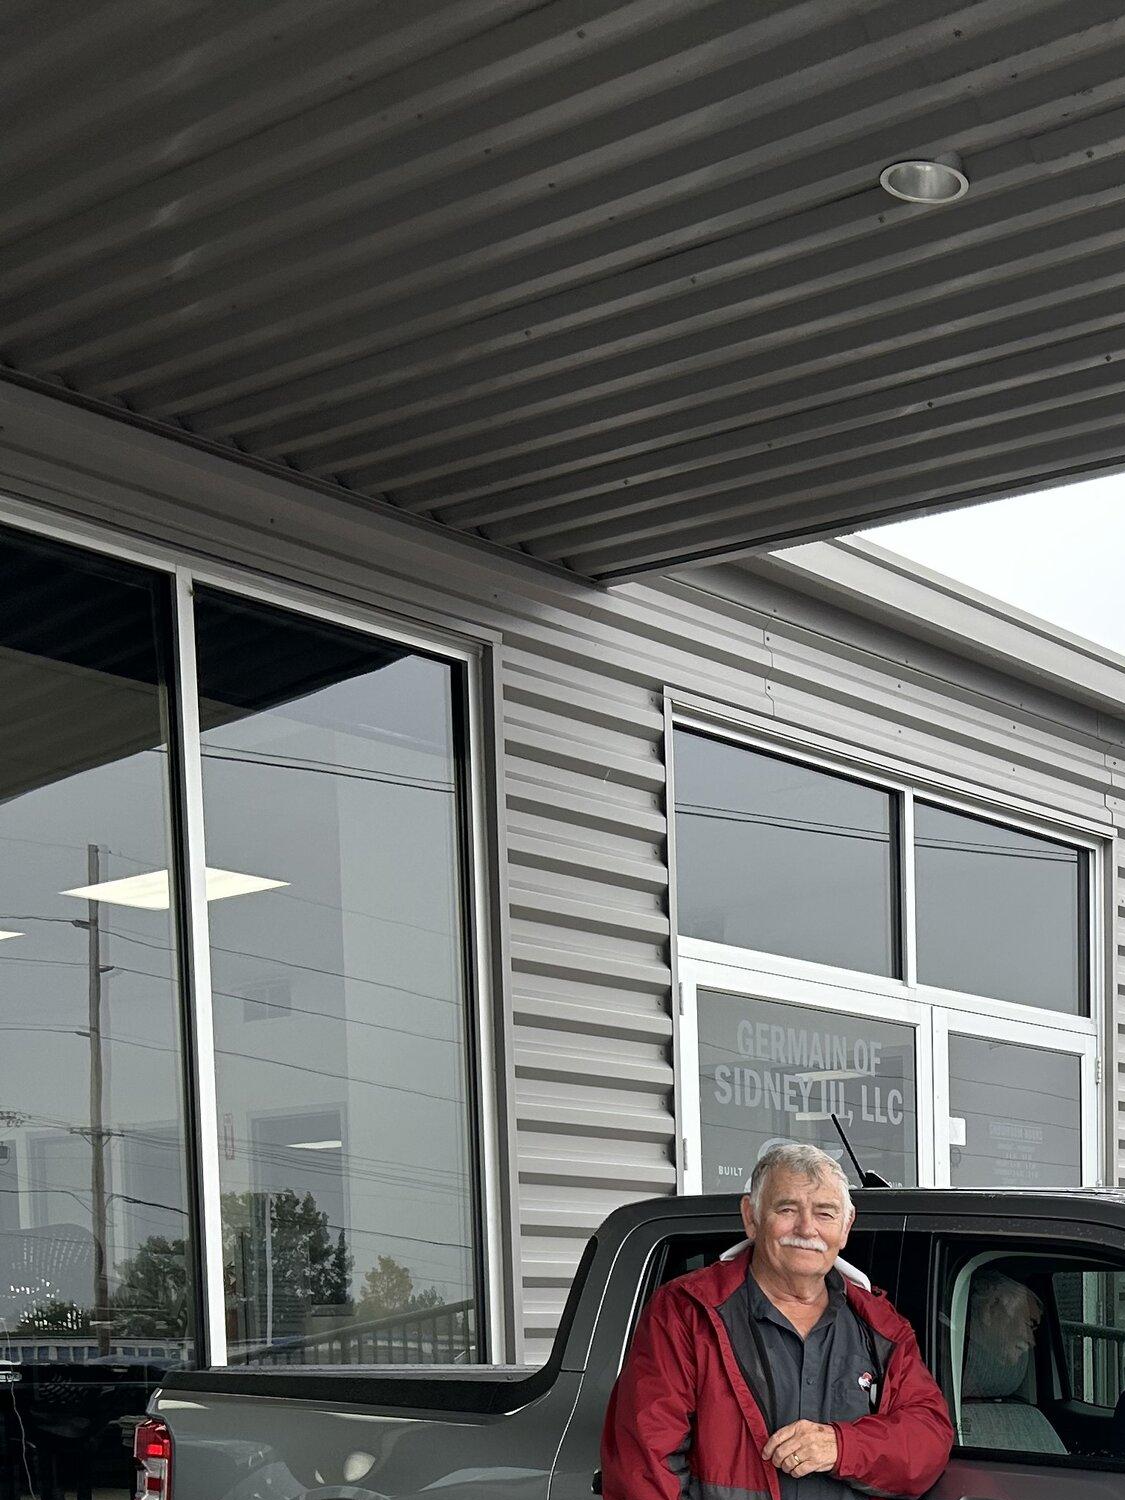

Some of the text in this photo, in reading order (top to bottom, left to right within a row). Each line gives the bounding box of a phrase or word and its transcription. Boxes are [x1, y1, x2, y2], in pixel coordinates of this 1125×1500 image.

[737, 1019, 882, 1077] GERMAIN OF
[714, 1064, 814, 1114] SIDNEY
[861, 1084, 904, 1126] LLC
[717, 1164, 744, 1178] BUILT
